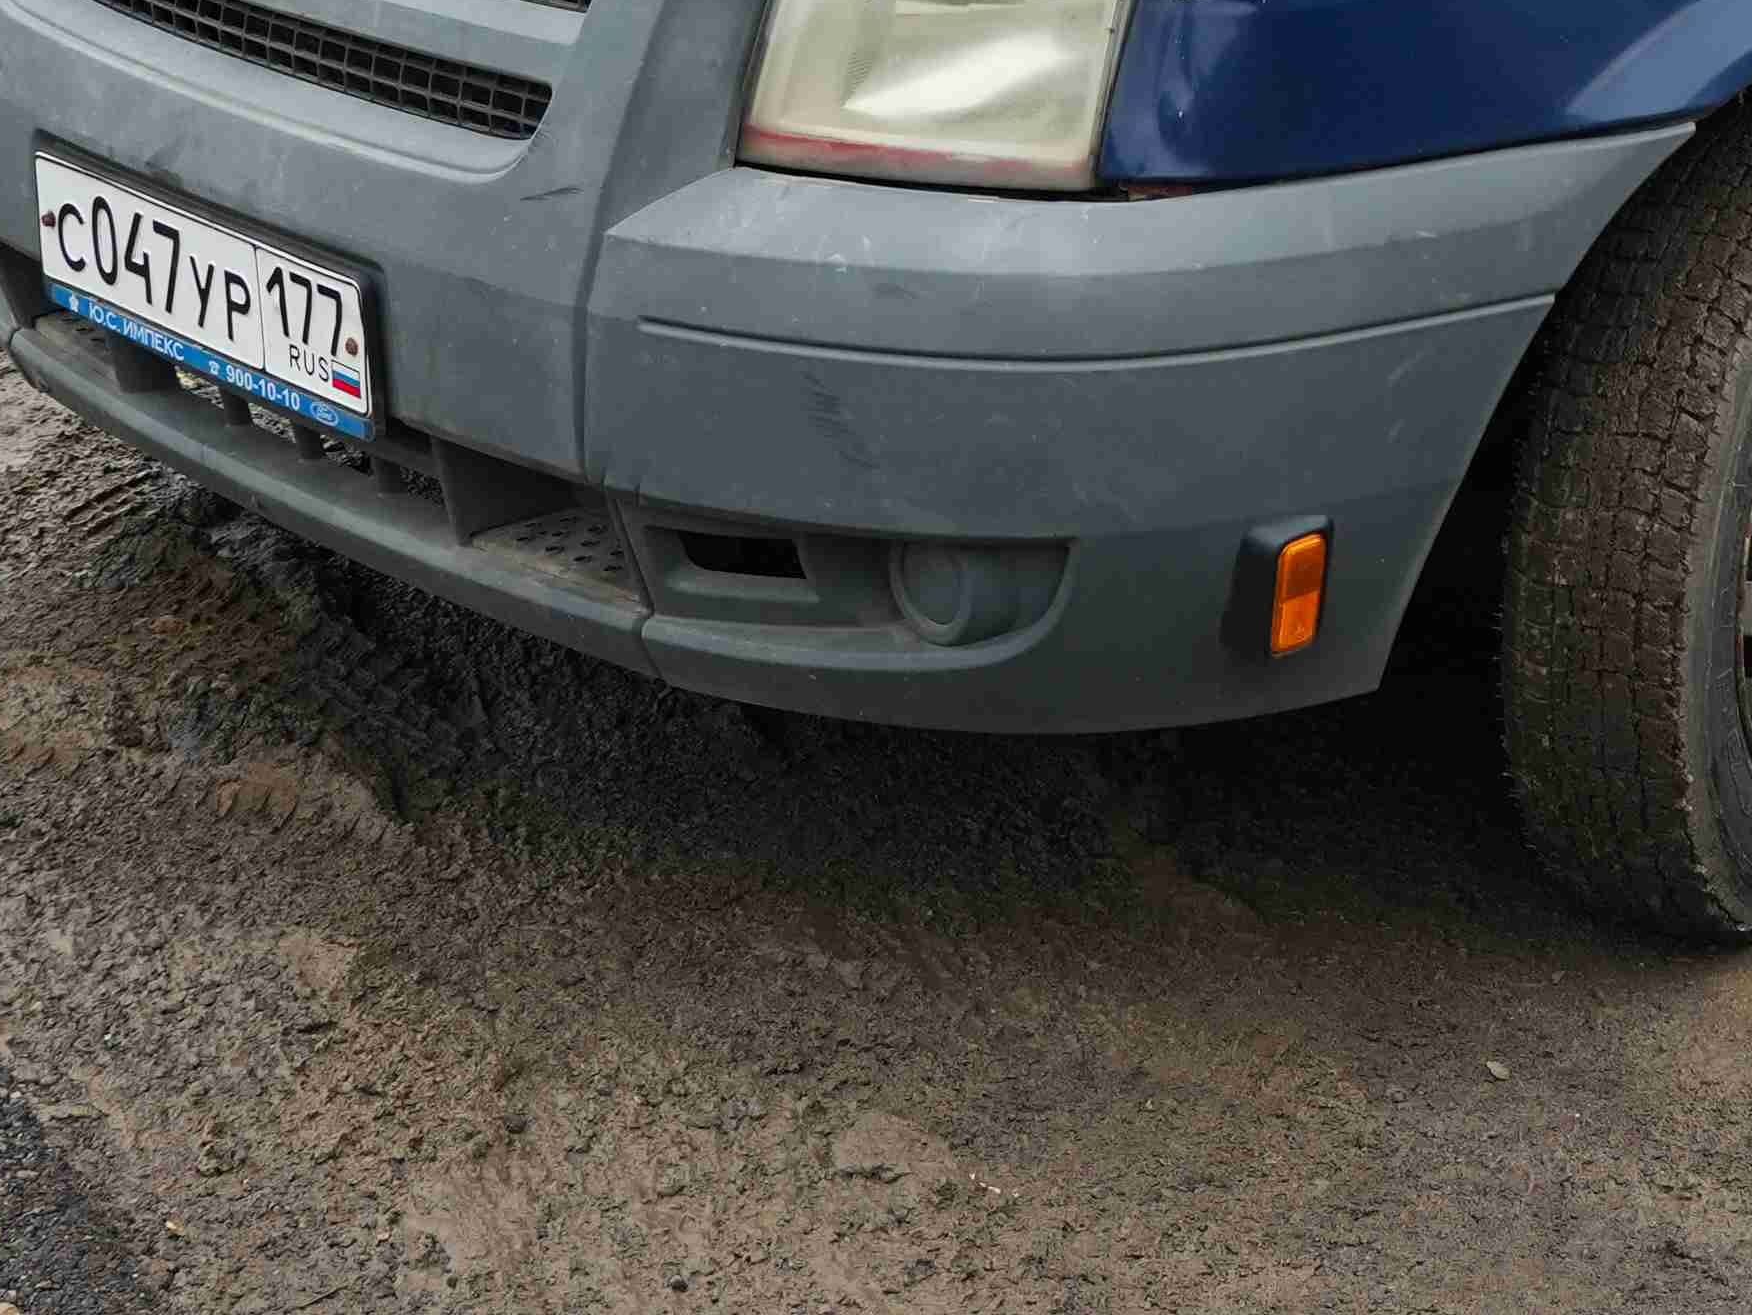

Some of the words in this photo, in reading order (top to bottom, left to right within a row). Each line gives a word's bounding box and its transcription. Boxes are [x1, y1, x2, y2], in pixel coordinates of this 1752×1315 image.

[266, 266, 343, 356] 177
[123, 321, 185, 362] ИМПЕКС
[226, 365, 300, 412] 900-10-10
[289, 343, 329, 383] RUS
